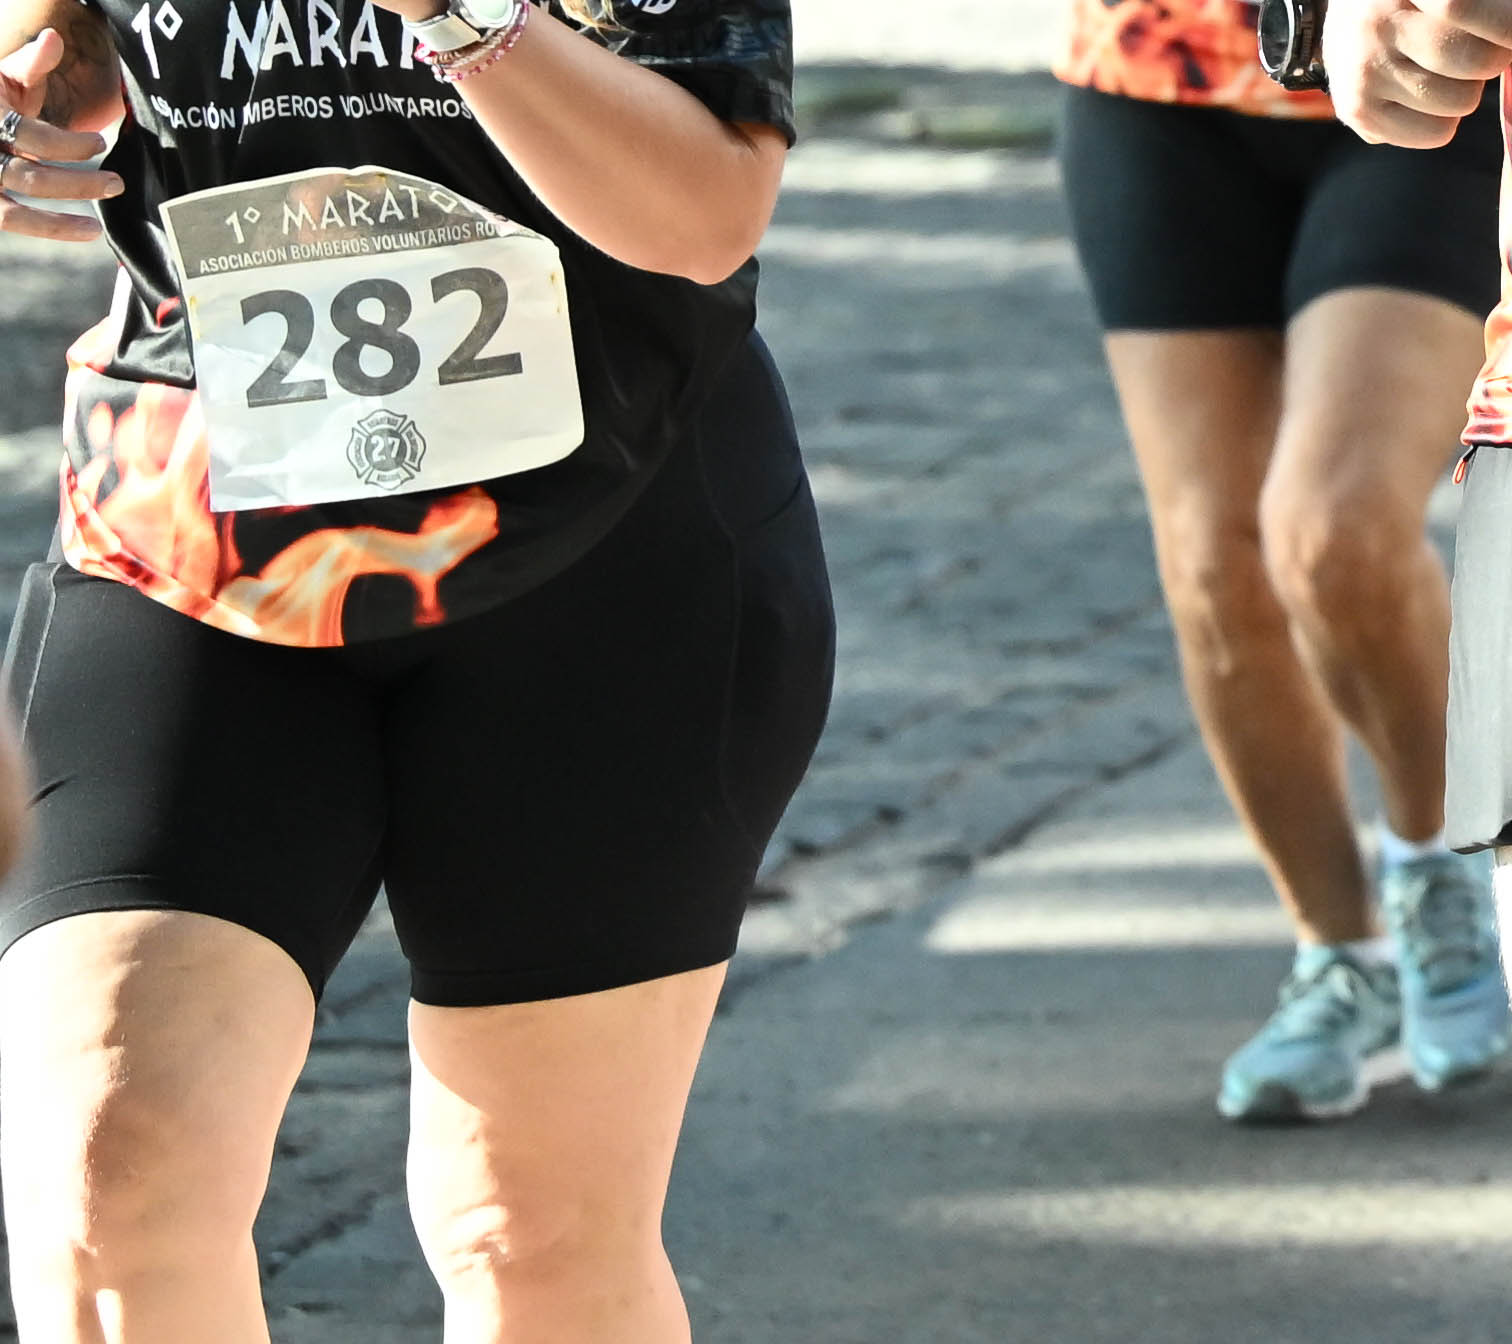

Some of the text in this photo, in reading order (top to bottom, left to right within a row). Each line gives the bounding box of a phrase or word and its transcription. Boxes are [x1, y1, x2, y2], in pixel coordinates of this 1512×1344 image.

[289, 236, 370, 260] BOMBEROS
[371, 222, 472, 253] VOLUNTARIOS
[240, 266, 524, 408] 282
[370, 434, 401, 463] 27
